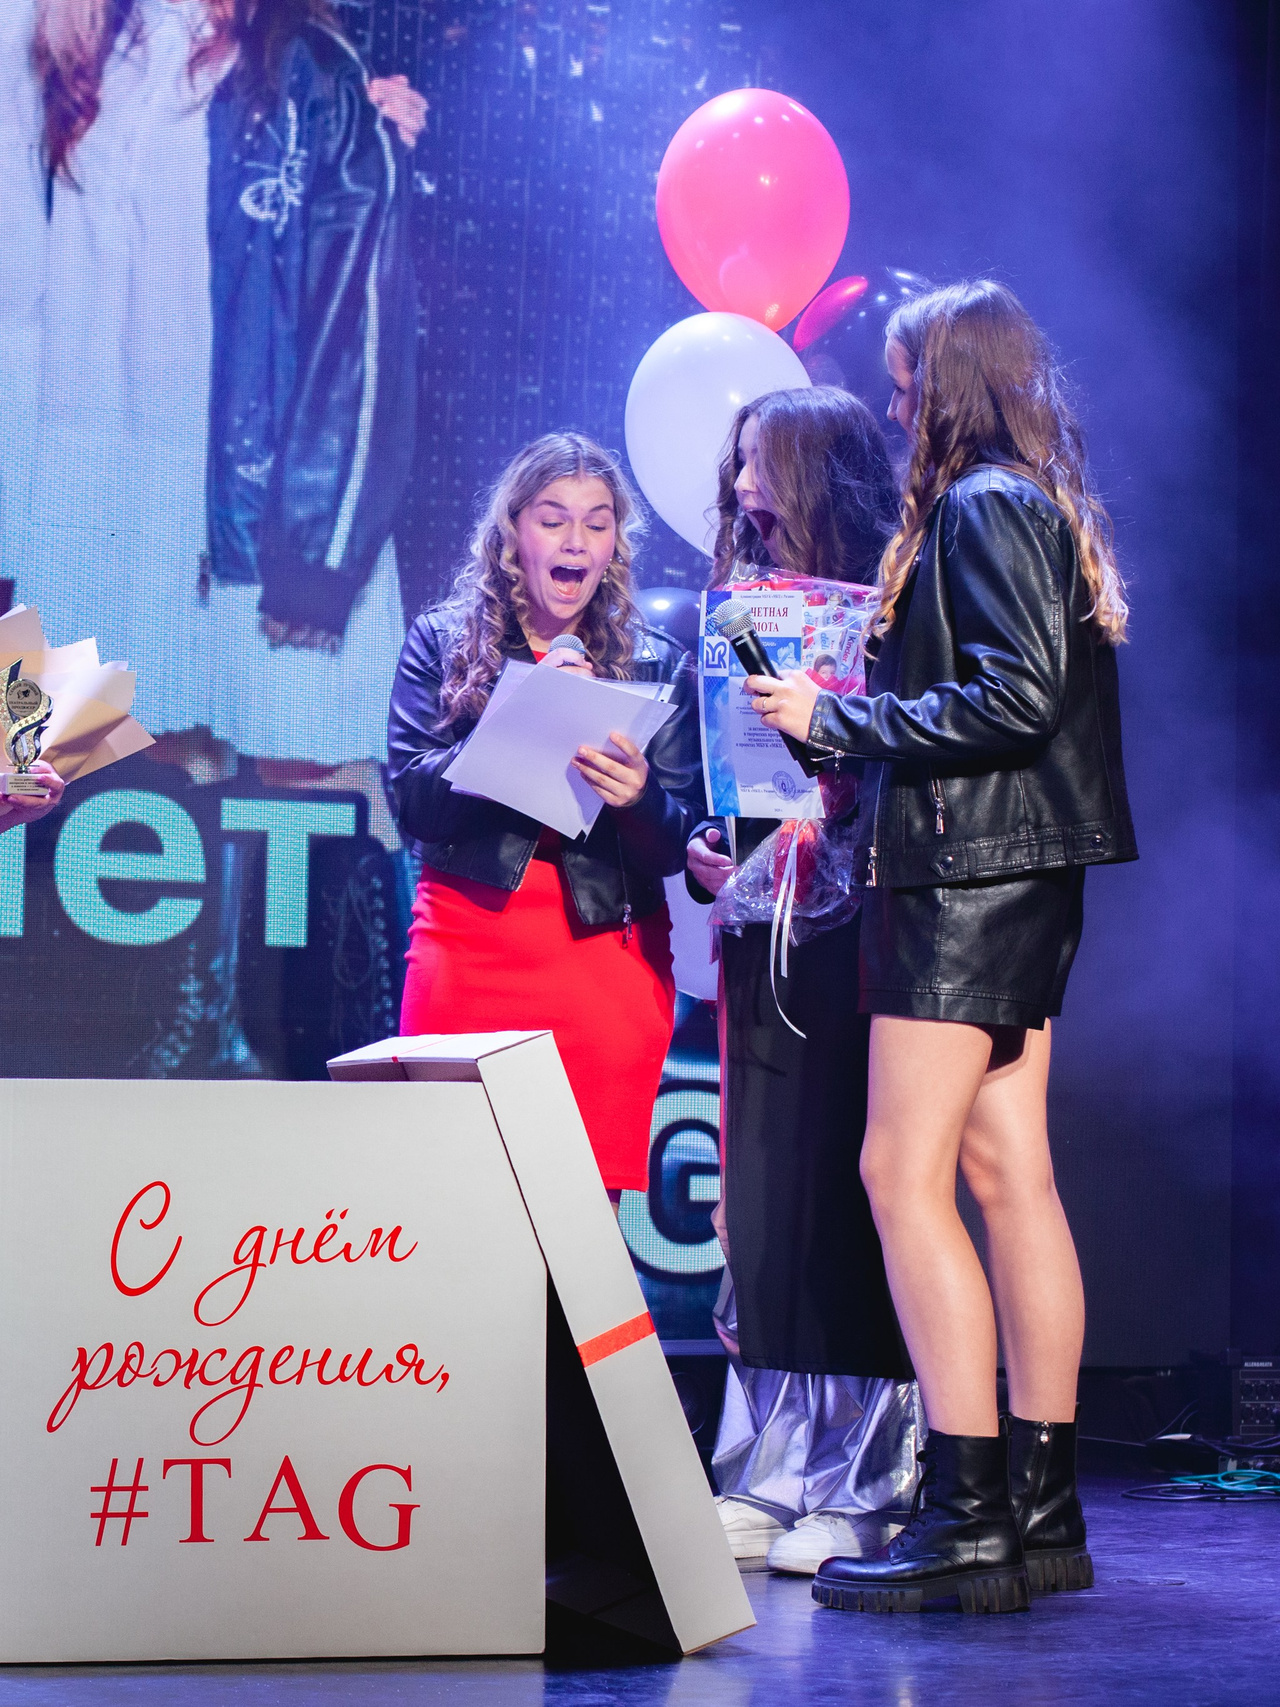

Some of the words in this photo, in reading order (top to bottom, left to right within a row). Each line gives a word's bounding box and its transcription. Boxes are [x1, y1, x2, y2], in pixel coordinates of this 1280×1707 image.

[751, 607, 789, 617] ЧЕТНАЯ
[753, 621, 779, 632] МОТА
[842, 635, 855, 662] Kinder
[110, 1180, 184, 1298] С
[193, 1207, 419, 1328] днём
[45, 1340, 451, 1447] рождения,
[89, 1454, 421, 1552] #TAG
